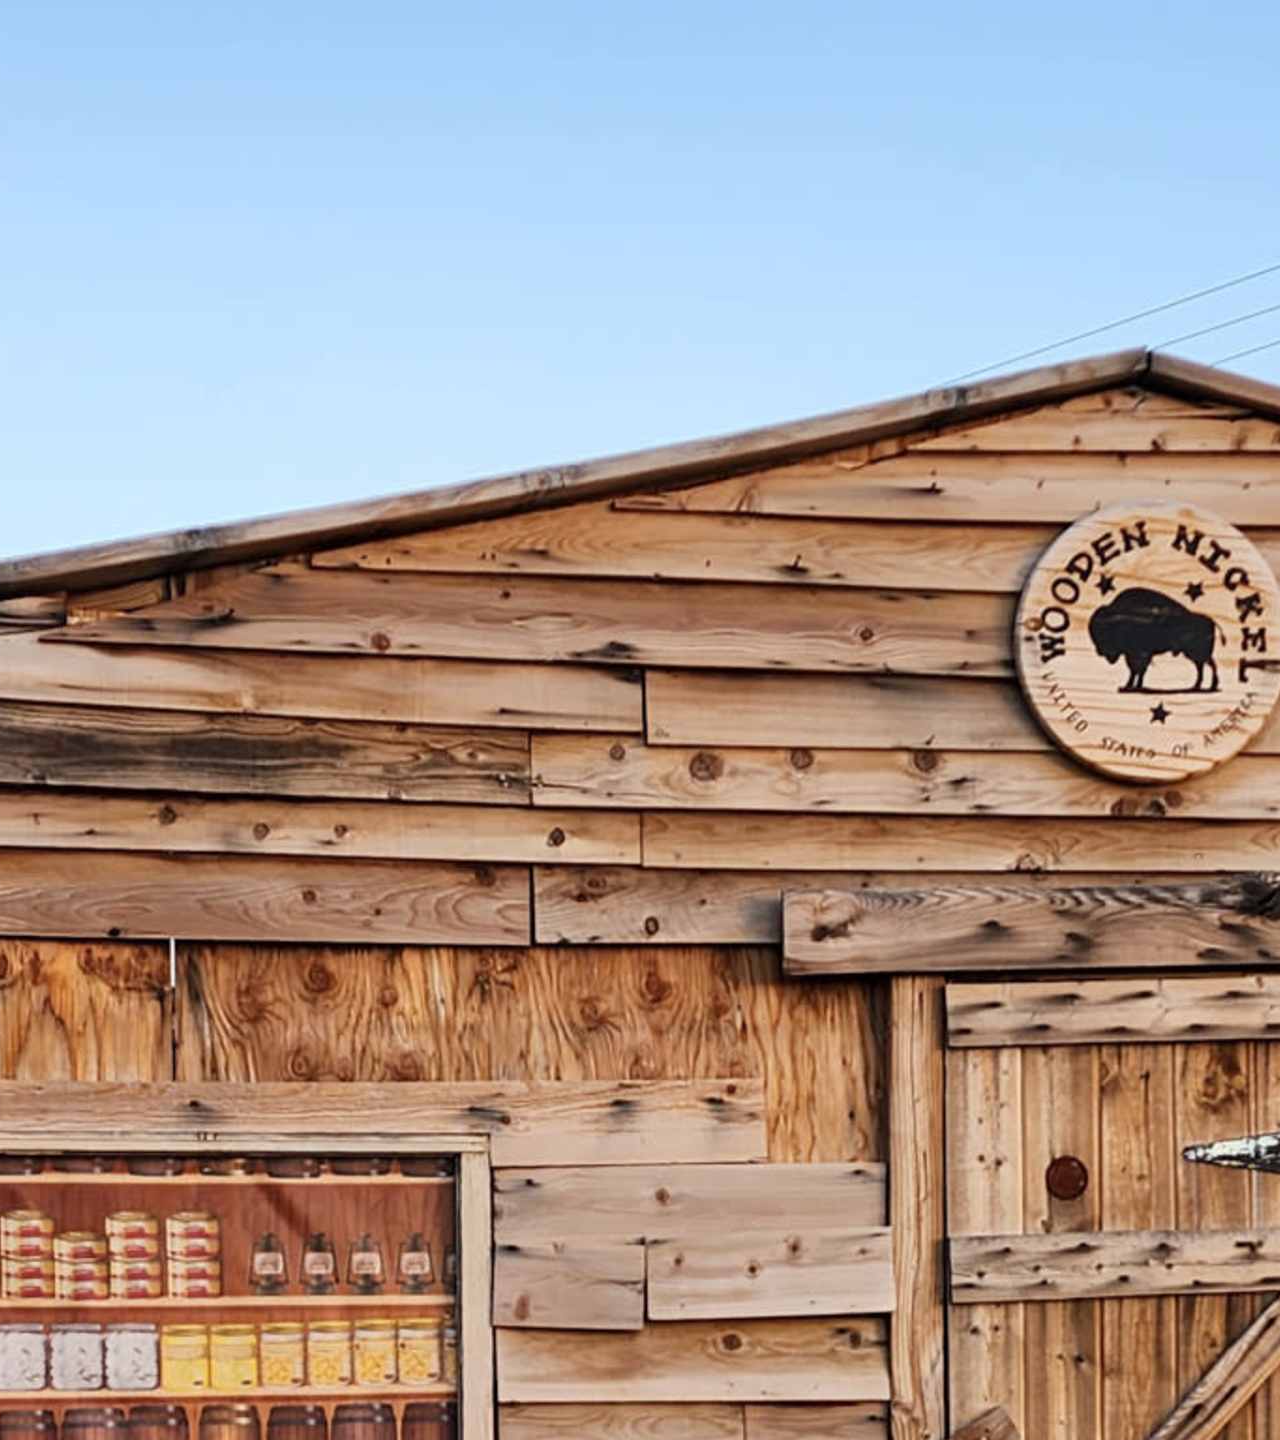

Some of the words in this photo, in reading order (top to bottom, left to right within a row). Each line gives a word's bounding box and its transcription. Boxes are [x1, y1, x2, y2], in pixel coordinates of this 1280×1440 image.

[1039, 520, 1150, 664] WOODEN
[1171, 524, 1280, 684] NICKEL
[1041, 670, 1090, 734] UNITED
